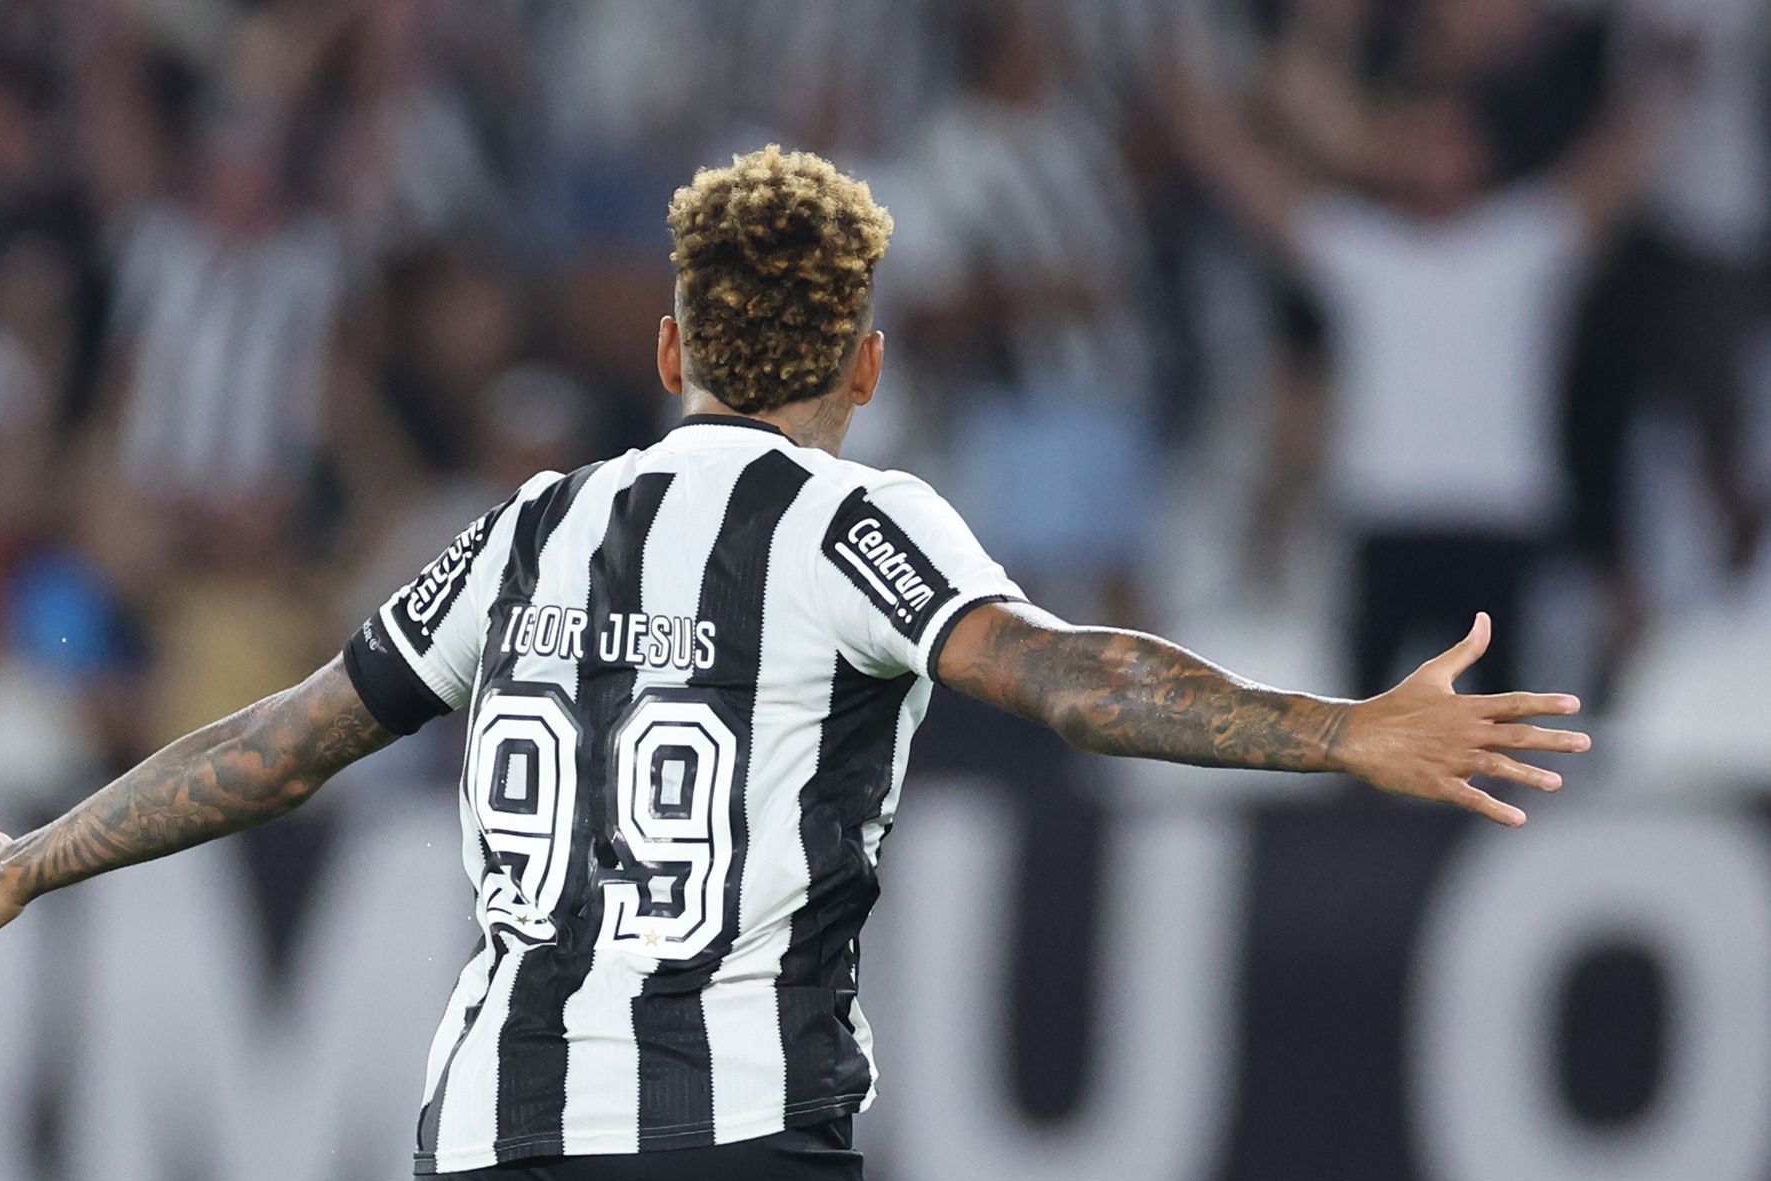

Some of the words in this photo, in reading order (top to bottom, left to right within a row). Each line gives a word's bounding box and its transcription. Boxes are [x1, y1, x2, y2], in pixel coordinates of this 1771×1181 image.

[847, 517, 935, 612] Centrum
[500, 605, 588, 658] IGOR
[599, 612, 717, 670] JESUS
[468, 693, 736, 961] 99
